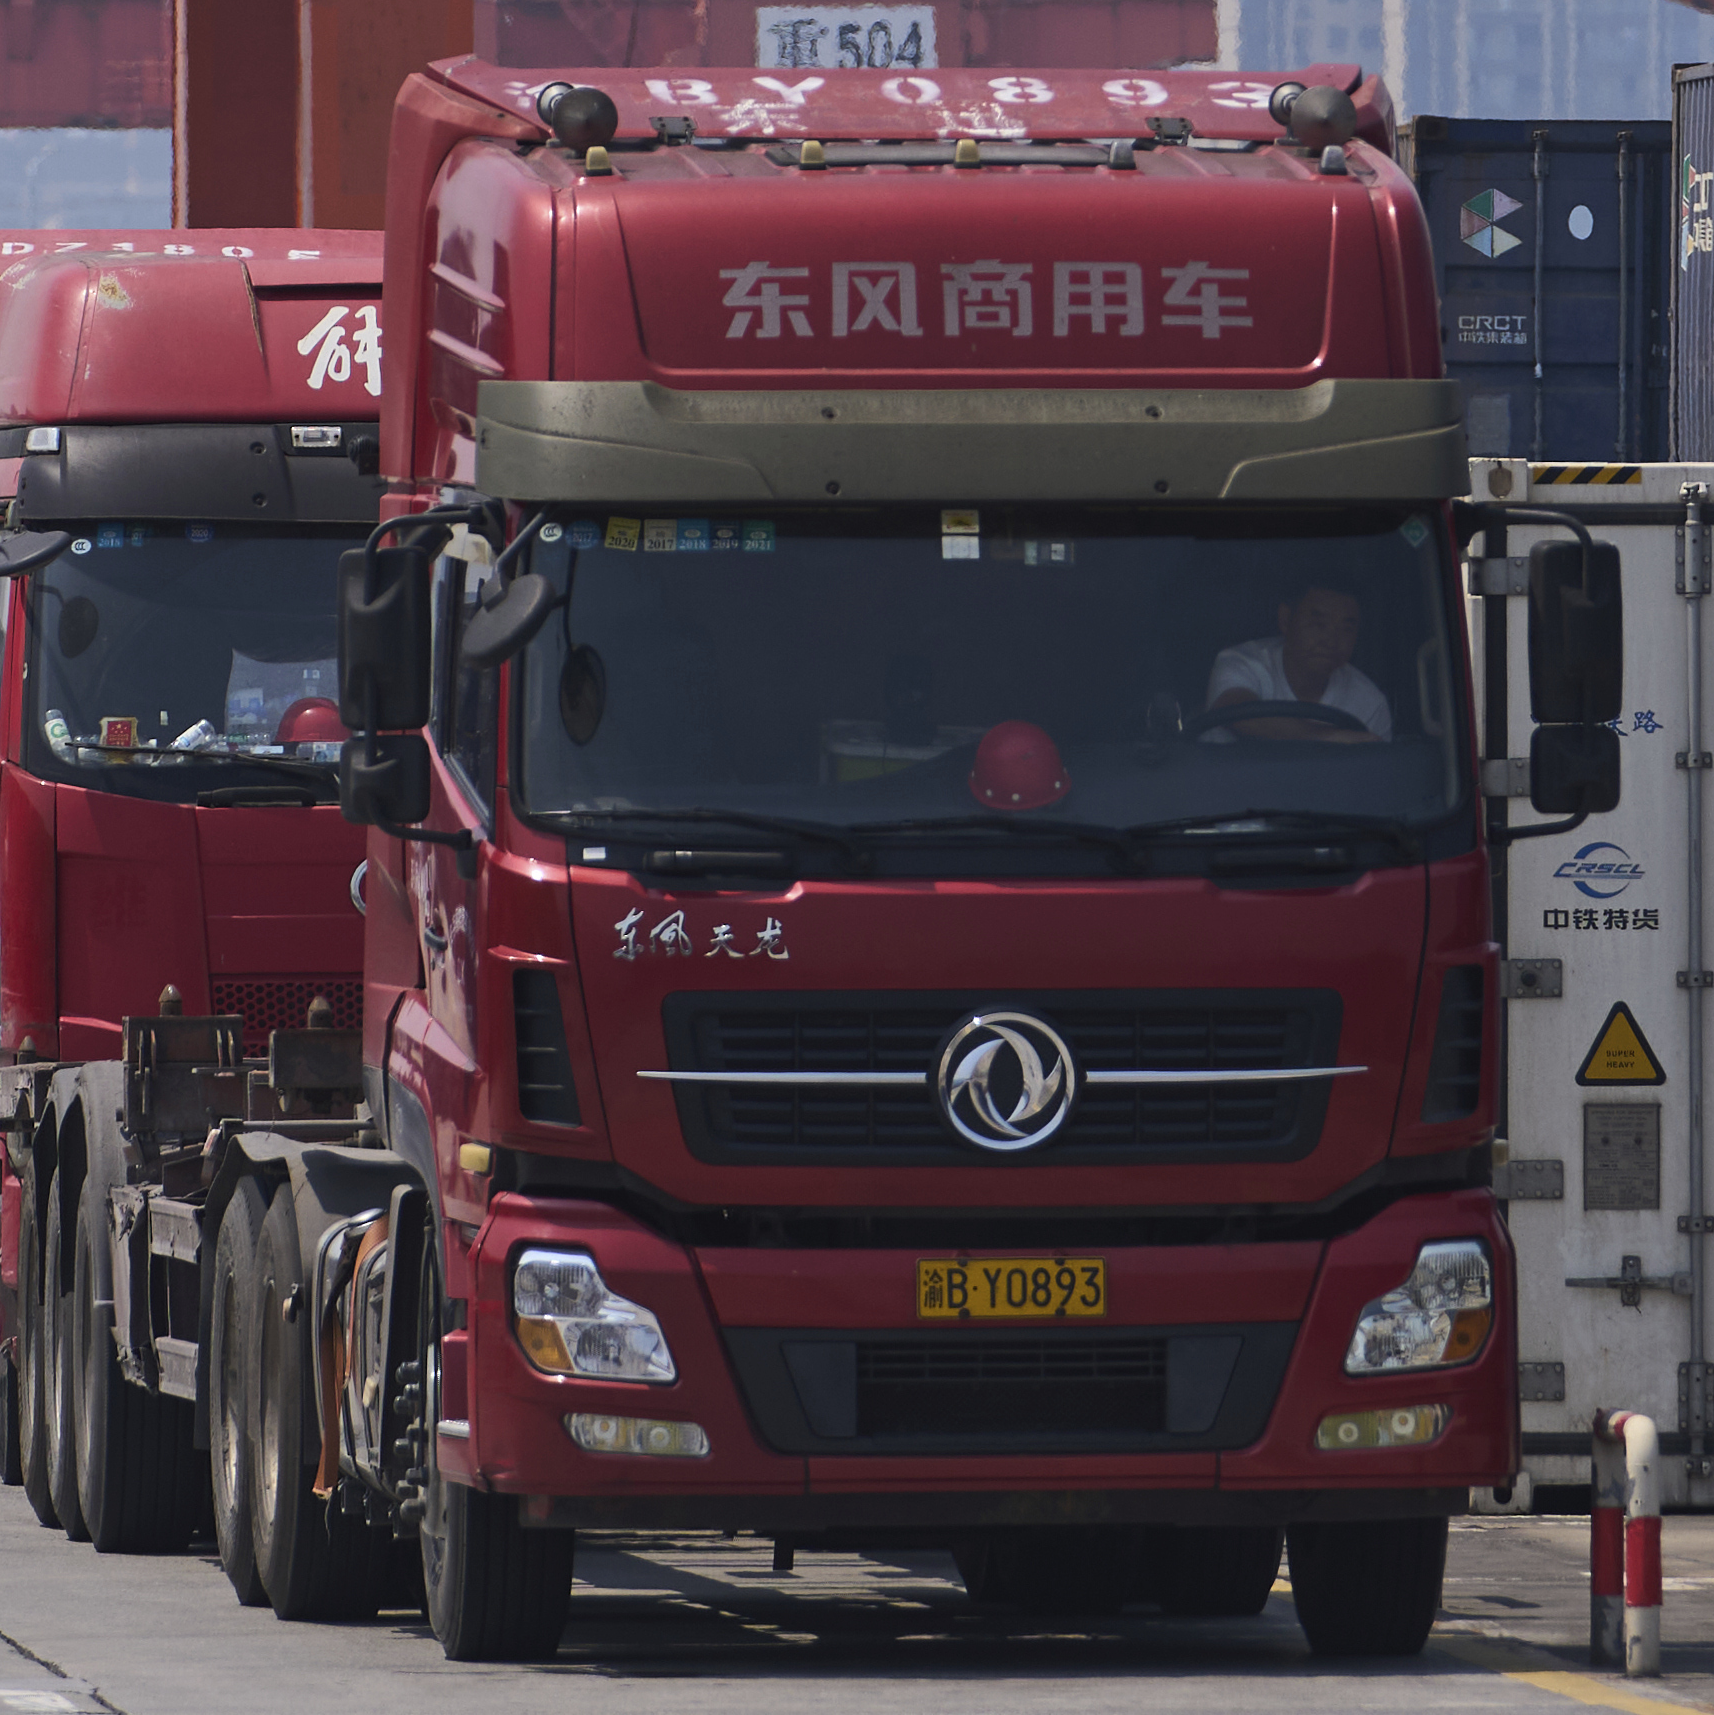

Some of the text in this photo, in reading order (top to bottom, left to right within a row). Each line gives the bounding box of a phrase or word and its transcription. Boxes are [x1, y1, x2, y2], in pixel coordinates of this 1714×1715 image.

[718, 260, 1254, 339] 东风商用车
[1457, 315, 1528, 331] CRCT
[647, 537, 675, 549] 2017
[1552, 862, 1646, 879] CRSCL
[1543, 908, 1660, 930] 中铁特货
[1606, 1050, 1635, 1058] SUPER
[1606, 1061, 1635, 1069] HEAVY
